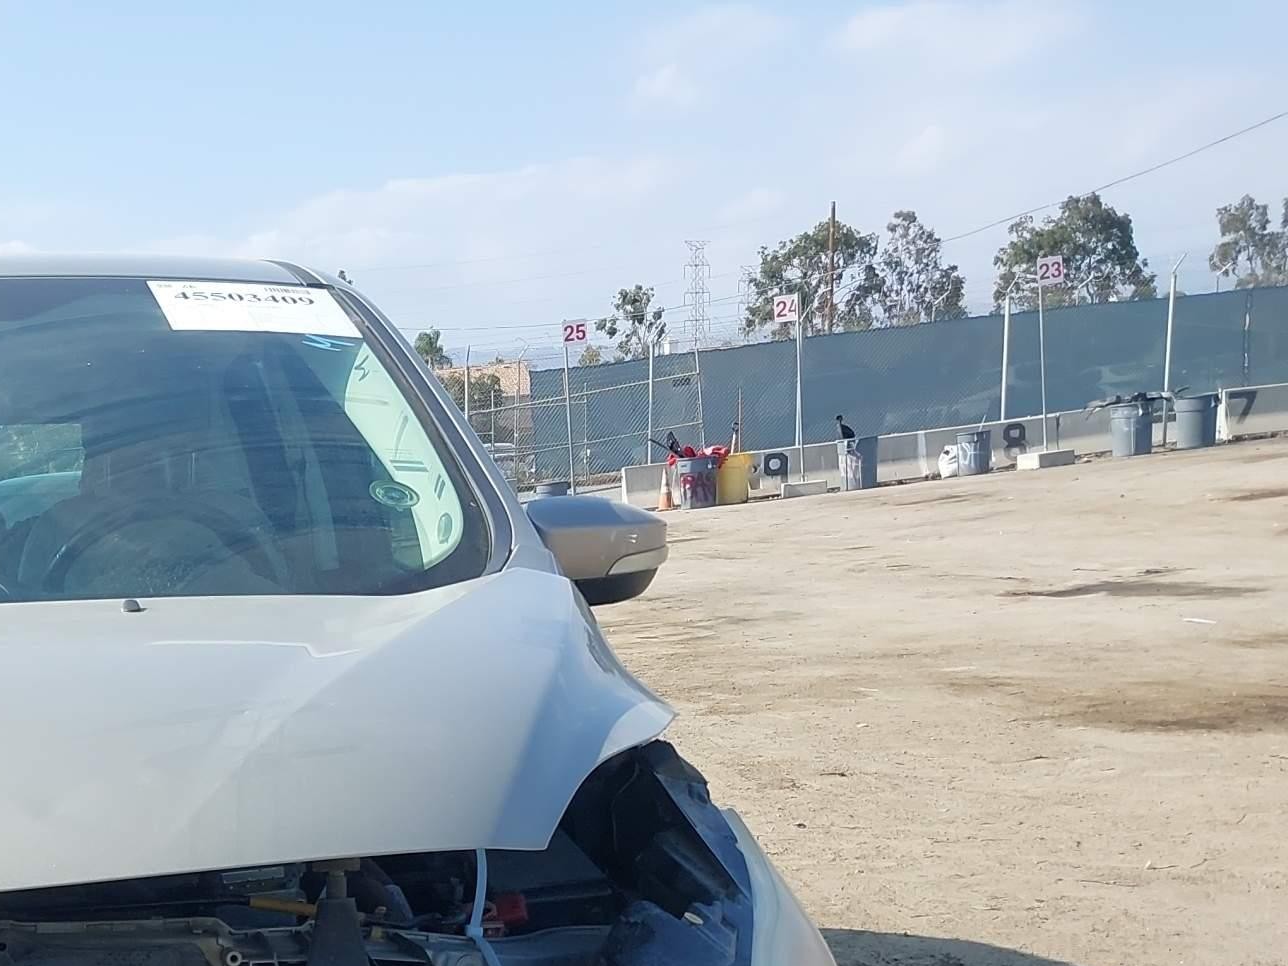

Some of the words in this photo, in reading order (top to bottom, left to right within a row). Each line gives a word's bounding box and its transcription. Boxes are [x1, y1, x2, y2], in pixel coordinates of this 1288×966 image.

[1039, 261, 1062, 280] 23
[175, 291, 315, 305] 45503409
[776, 299, 797, 318] 24
[564, 323, 586, 342] 25
[1228, 391, 1257, 424] 7
[1003, 423, 1029, 460] 8
